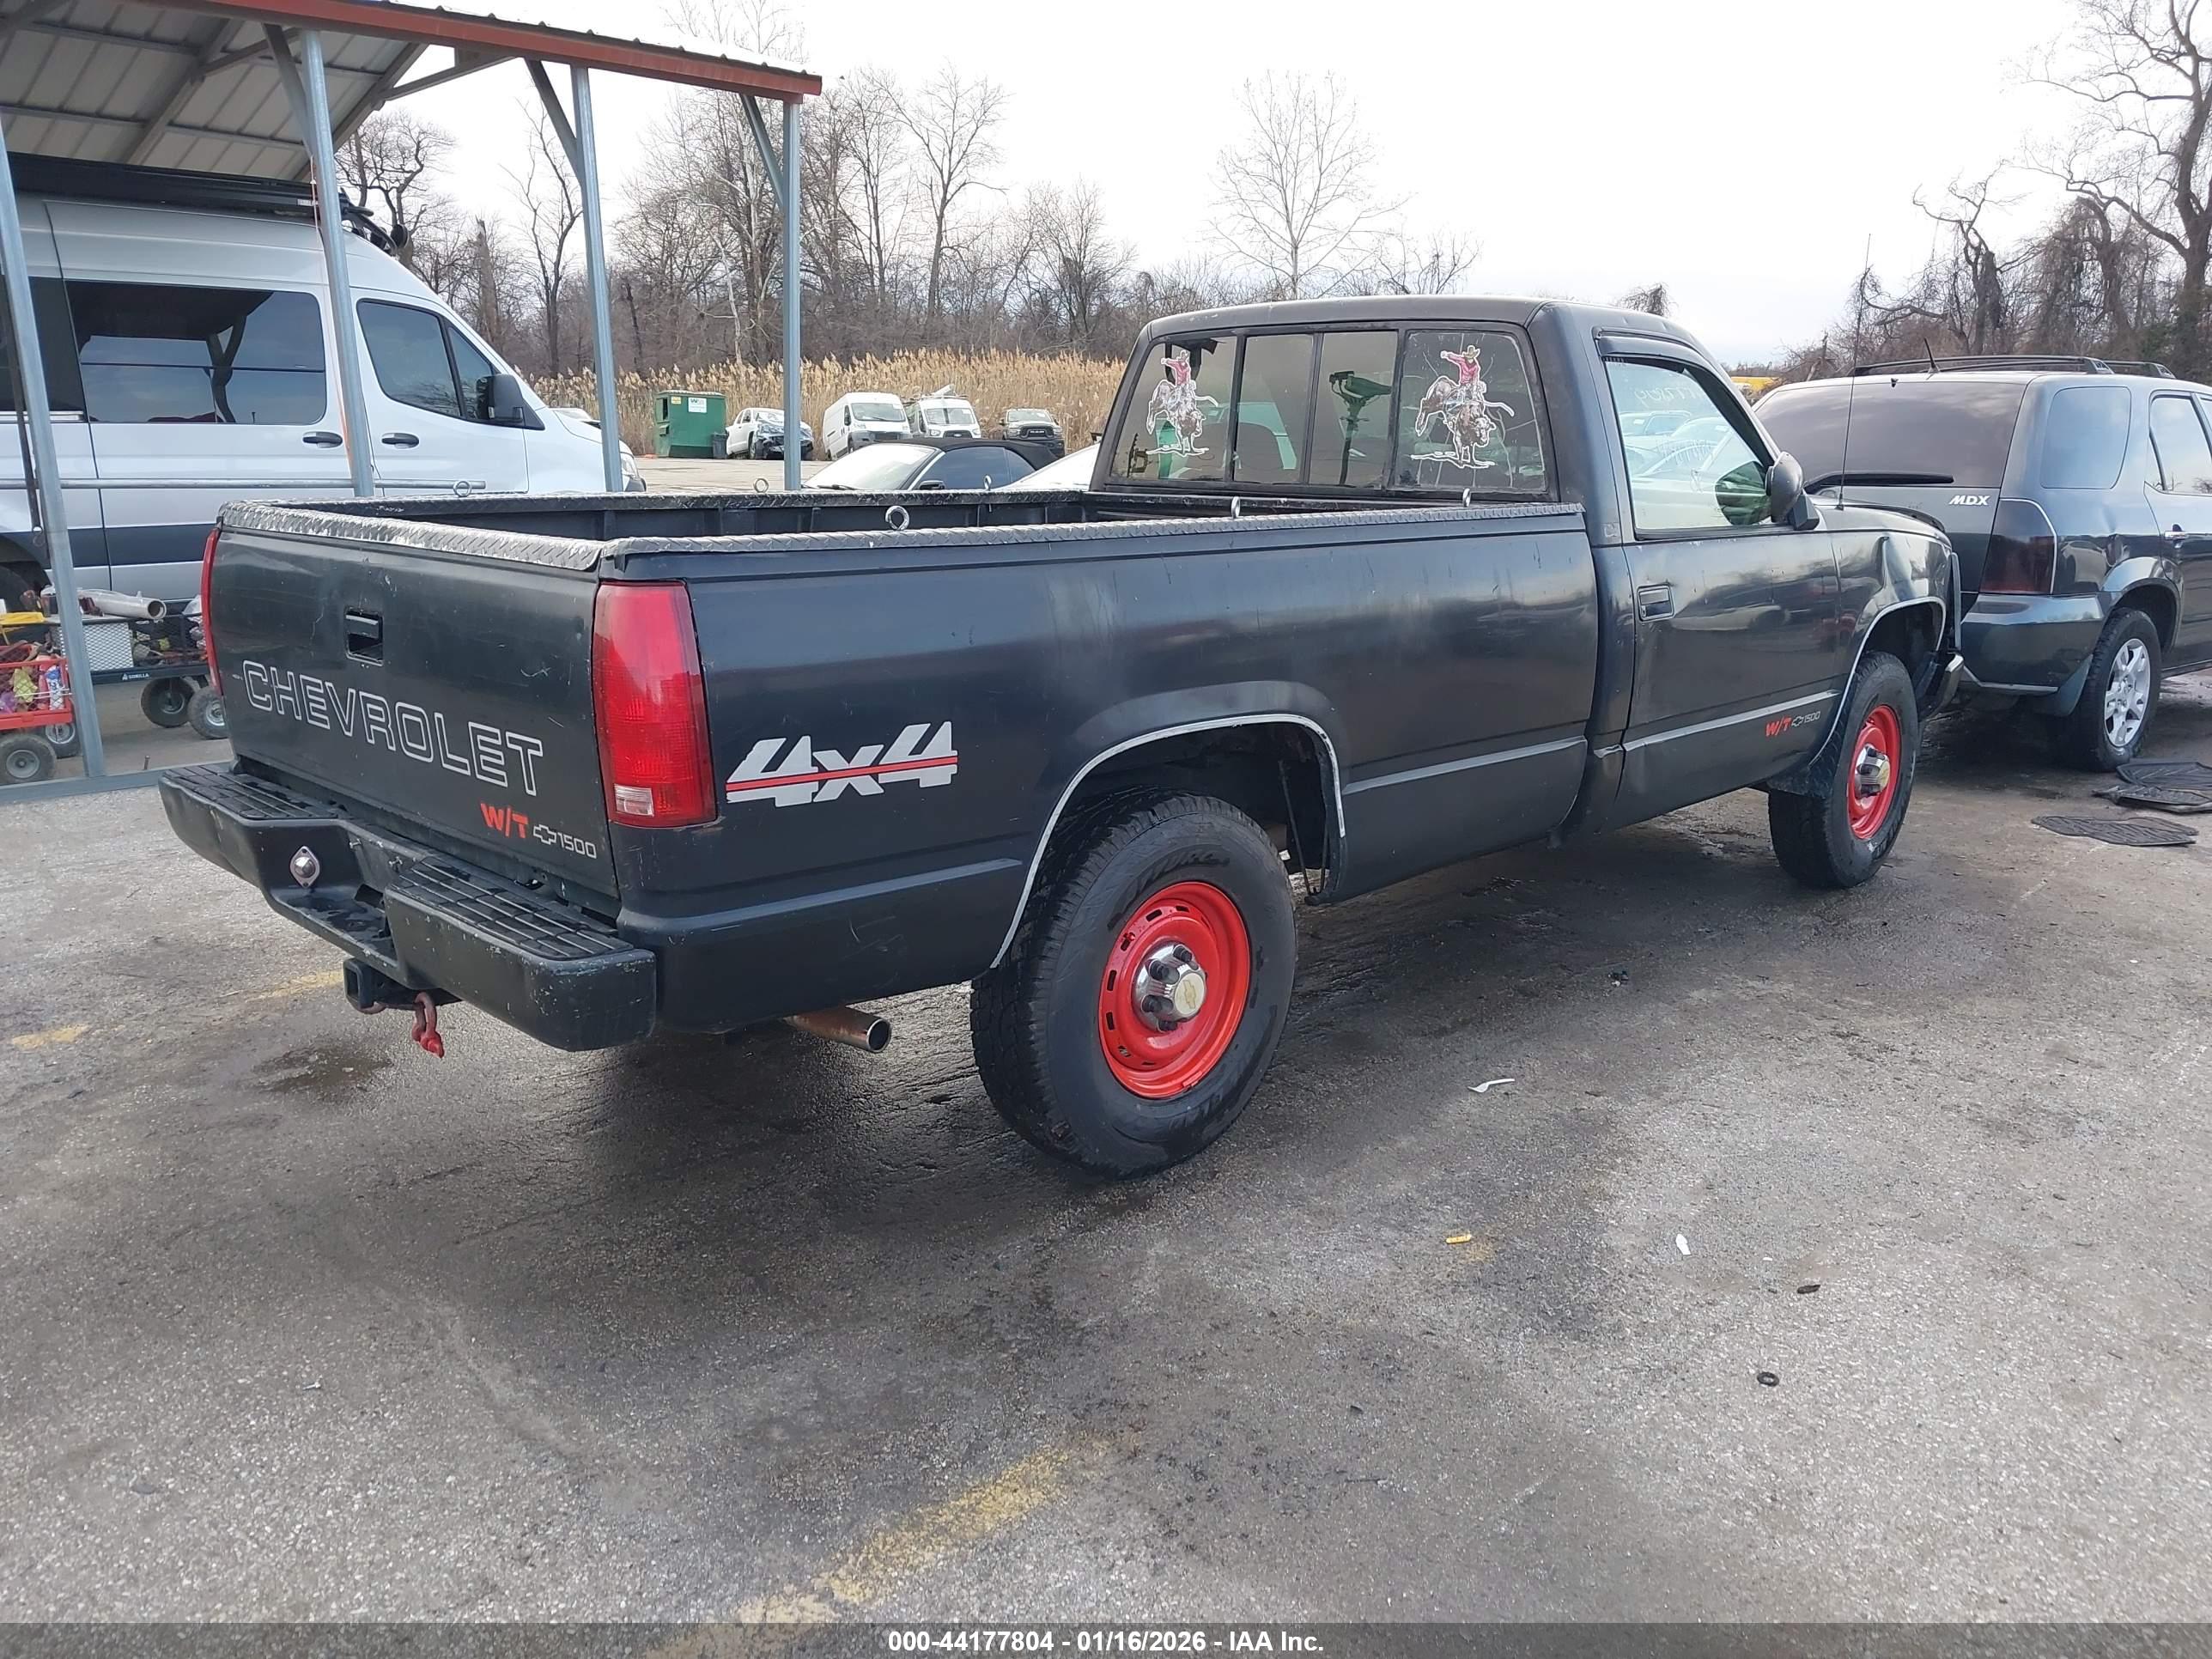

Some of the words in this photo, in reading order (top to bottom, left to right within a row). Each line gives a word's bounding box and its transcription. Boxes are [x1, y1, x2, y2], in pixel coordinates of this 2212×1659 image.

[1948, 495, 1990, 507] MDX
[243, 659, 544, 797] CHEVROLET
[1765, 715, 1793, 738] W/T
[1804, 710, 1821, 724] 1500
[725, 720, 958, 808] 4x4
[480, 802, 529, 839] W/T
[557, 831, 598, 860] 1500
